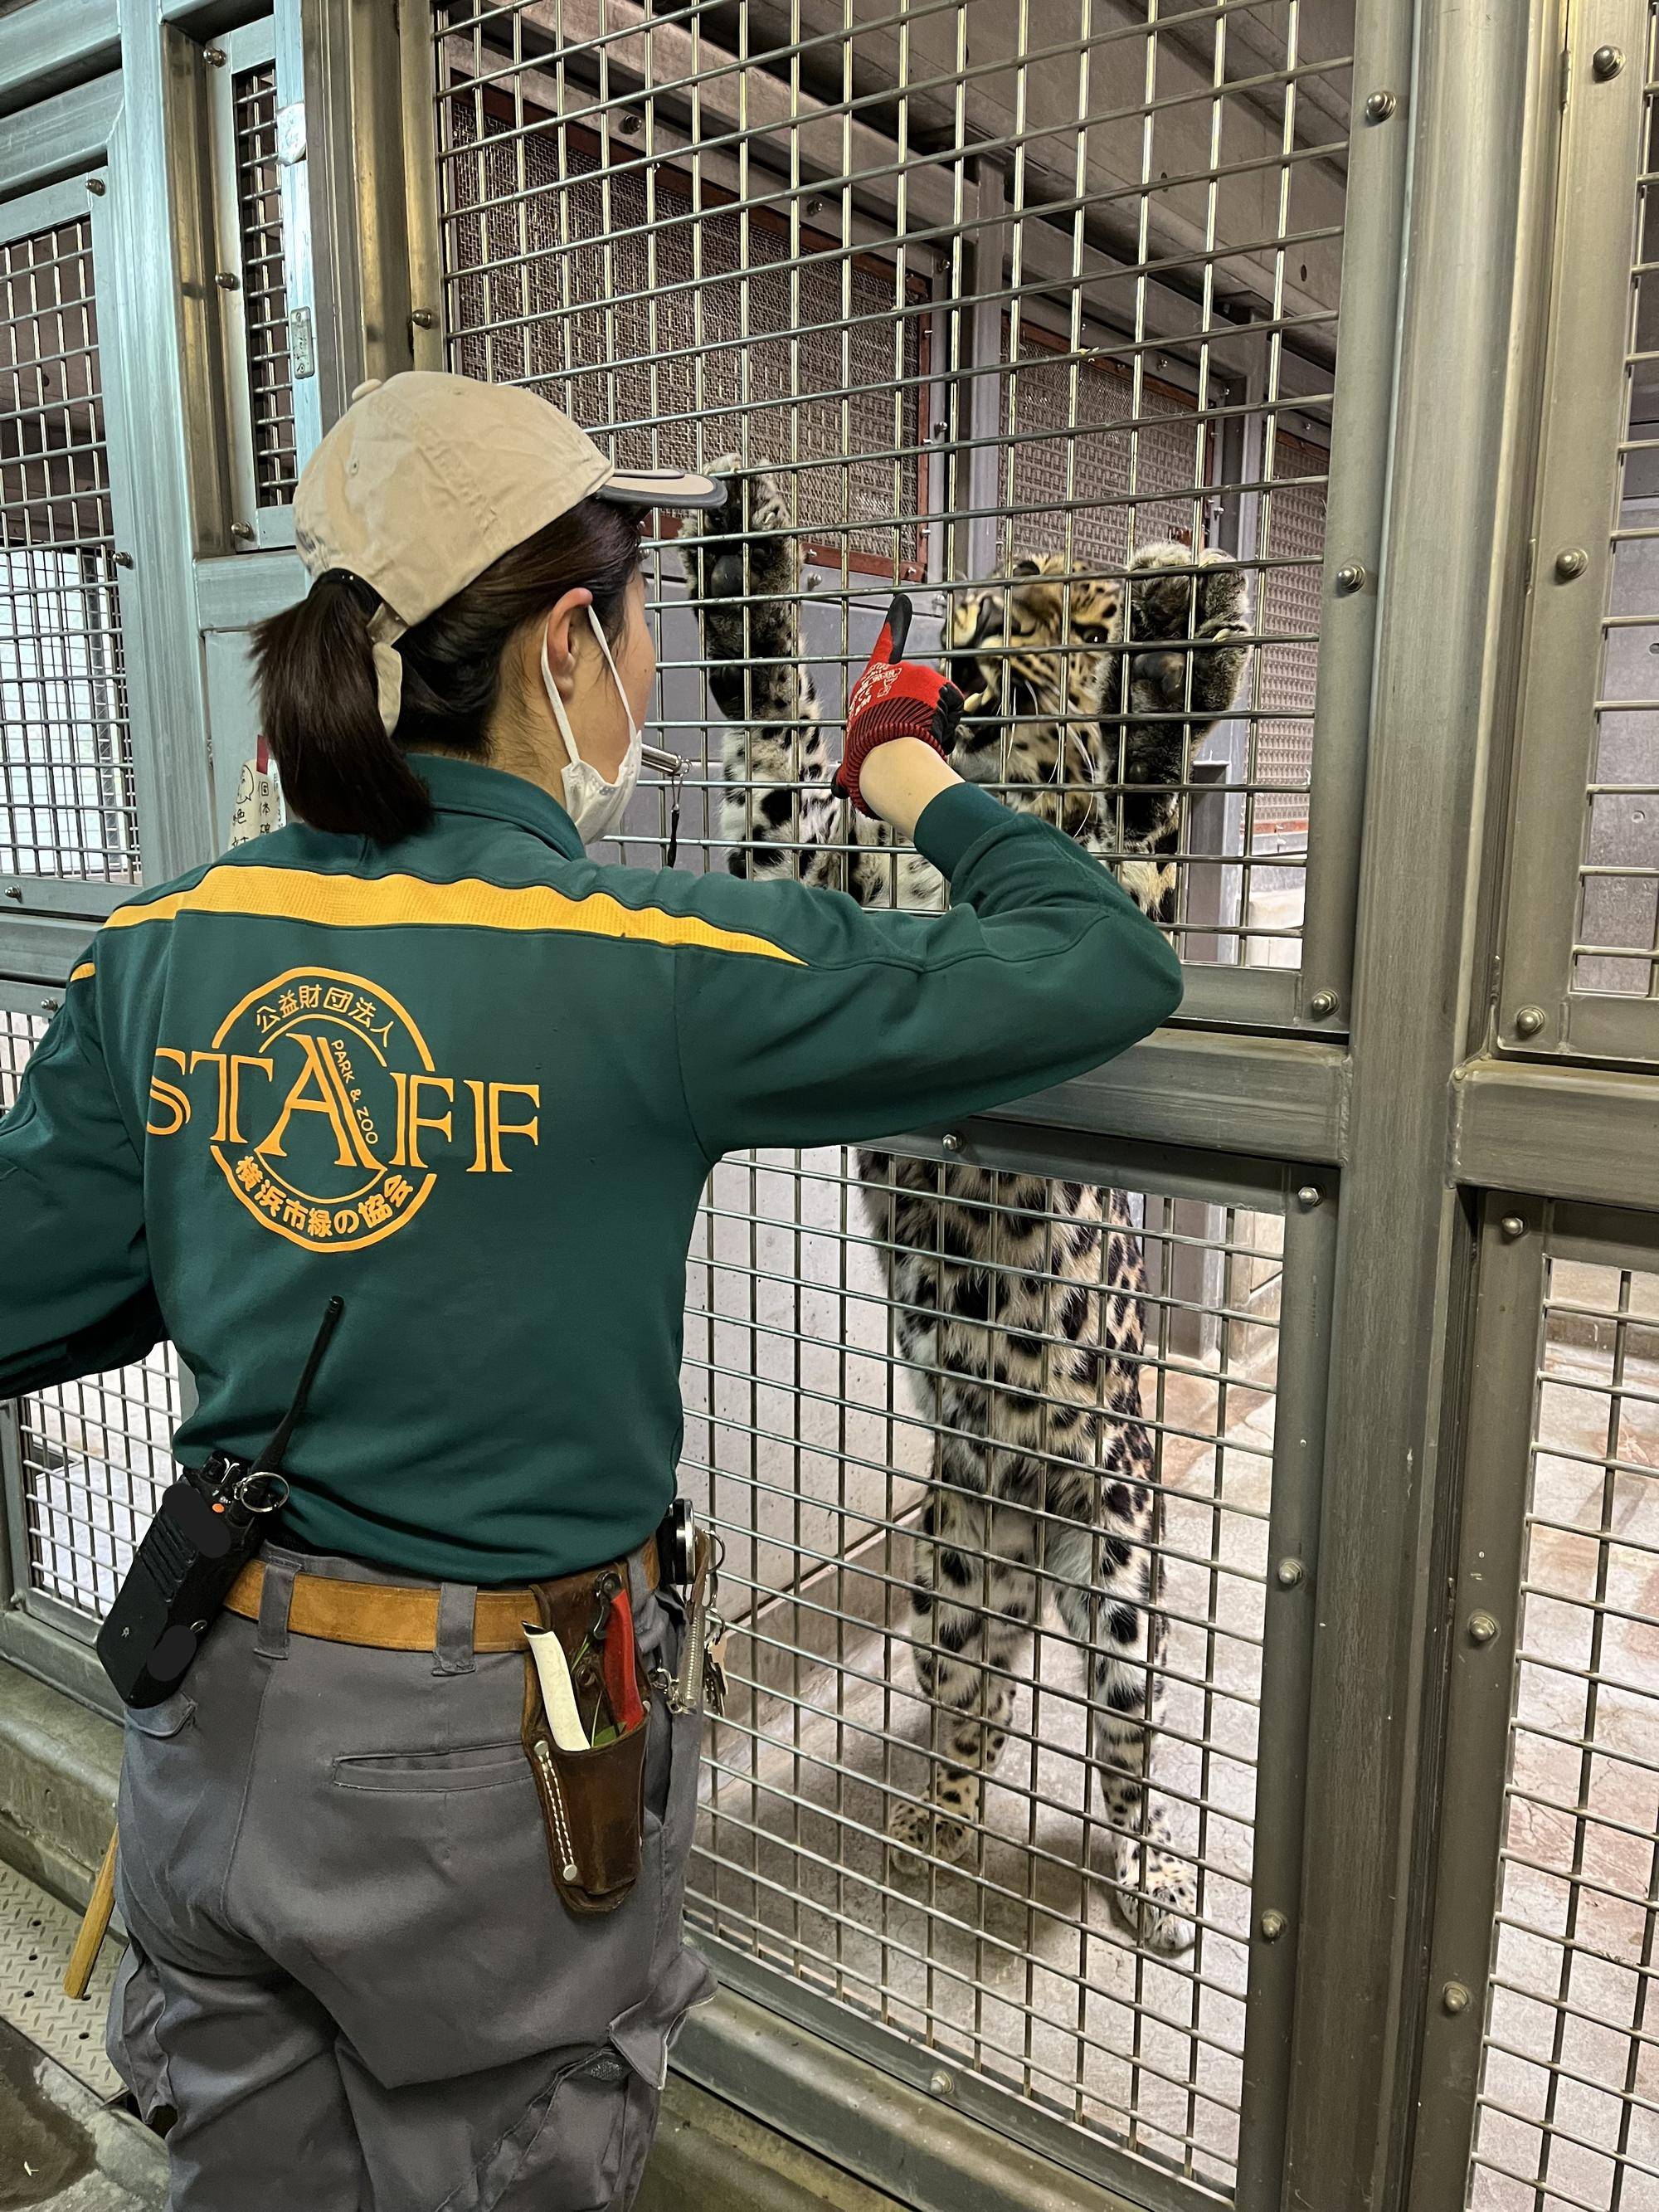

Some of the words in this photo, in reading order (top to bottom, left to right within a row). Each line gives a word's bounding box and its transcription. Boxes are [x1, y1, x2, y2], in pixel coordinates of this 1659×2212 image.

[256, 984, 394, 1049] 公益財団法人
[146, 1032, 540, 1172] STAFF
[331, 1039, 355, 1084] PARK
[350, 1089, 362, 1103] &
[356, 1106, 378, 1144] ZOO
[236, 1156, 414, 1237] 横浜市緑の協会
